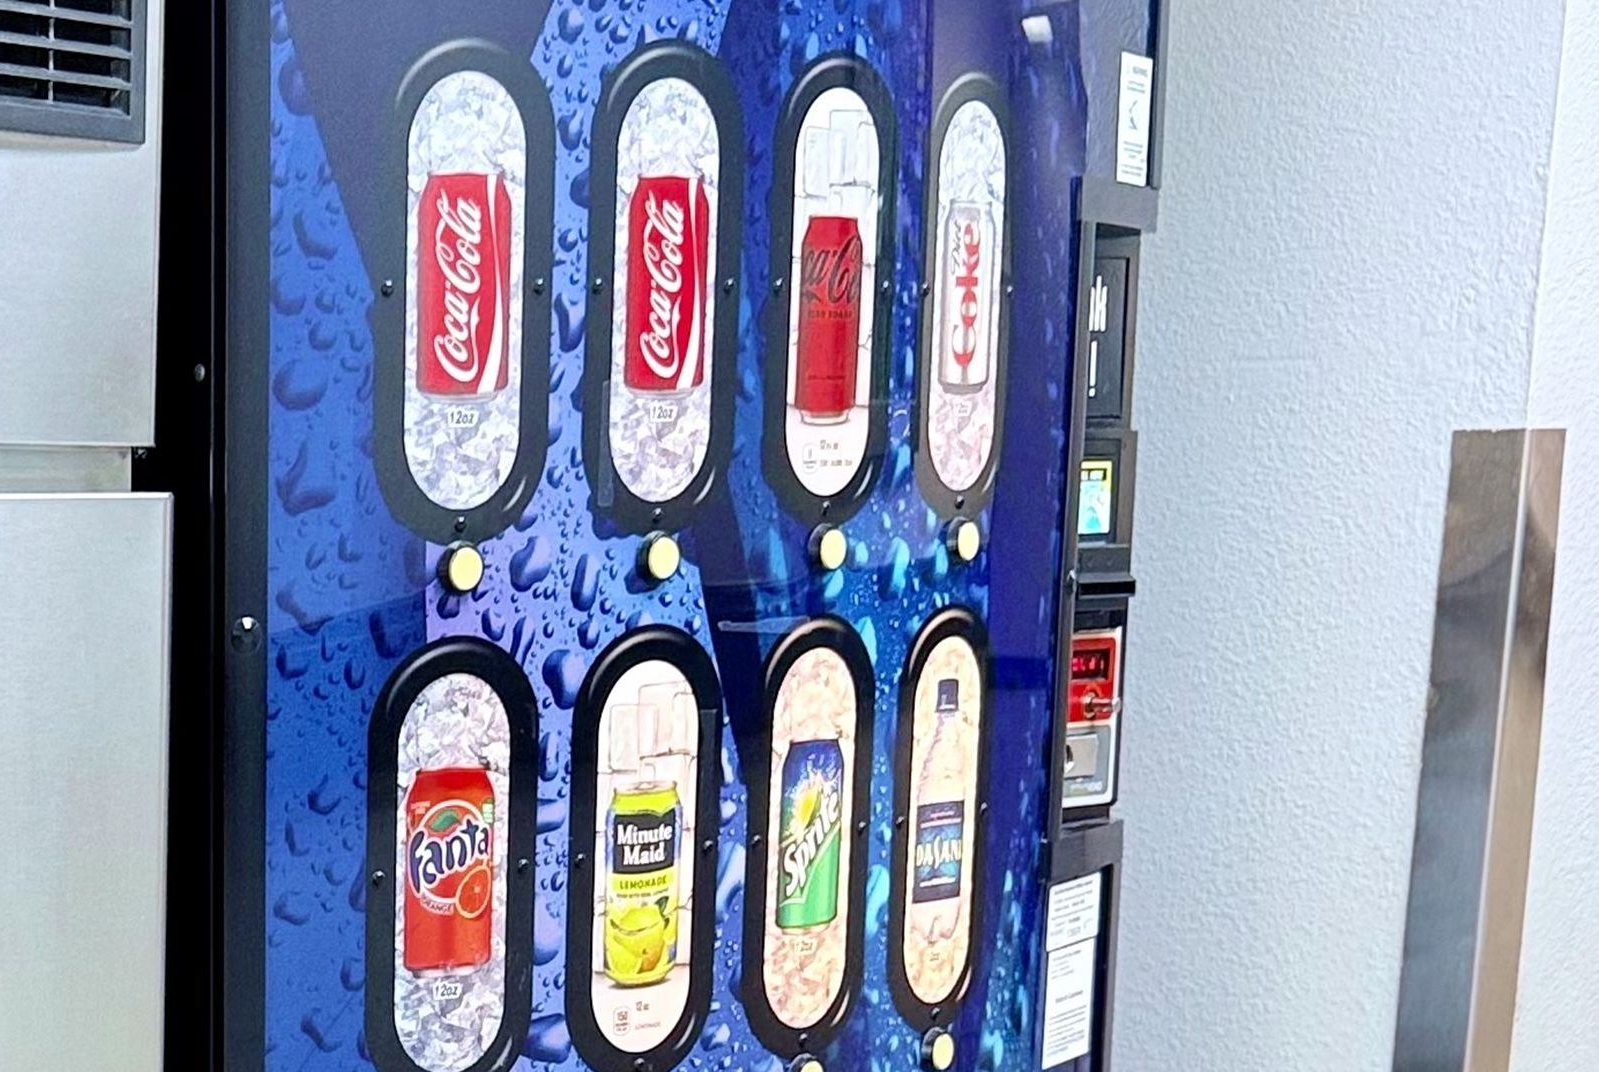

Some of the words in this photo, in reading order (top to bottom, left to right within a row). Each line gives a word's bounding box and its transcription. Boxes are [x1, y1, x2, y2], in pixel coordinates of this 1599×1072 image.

[433, 188, 481, 382] Coca-Cola
[640, 189, 685, 379] Coca-Cola
[952, 223, 981, 368] Coke
[410, 818, 489, 893] Fanta
[617, 823, 673, 845] Minute
[623, 842, 666, 865] Maid
[784, 793, 839, 897] Sprite
[916, 835, 962, 869] DASANI
[620, 875, 667, 890] LEMONADE
